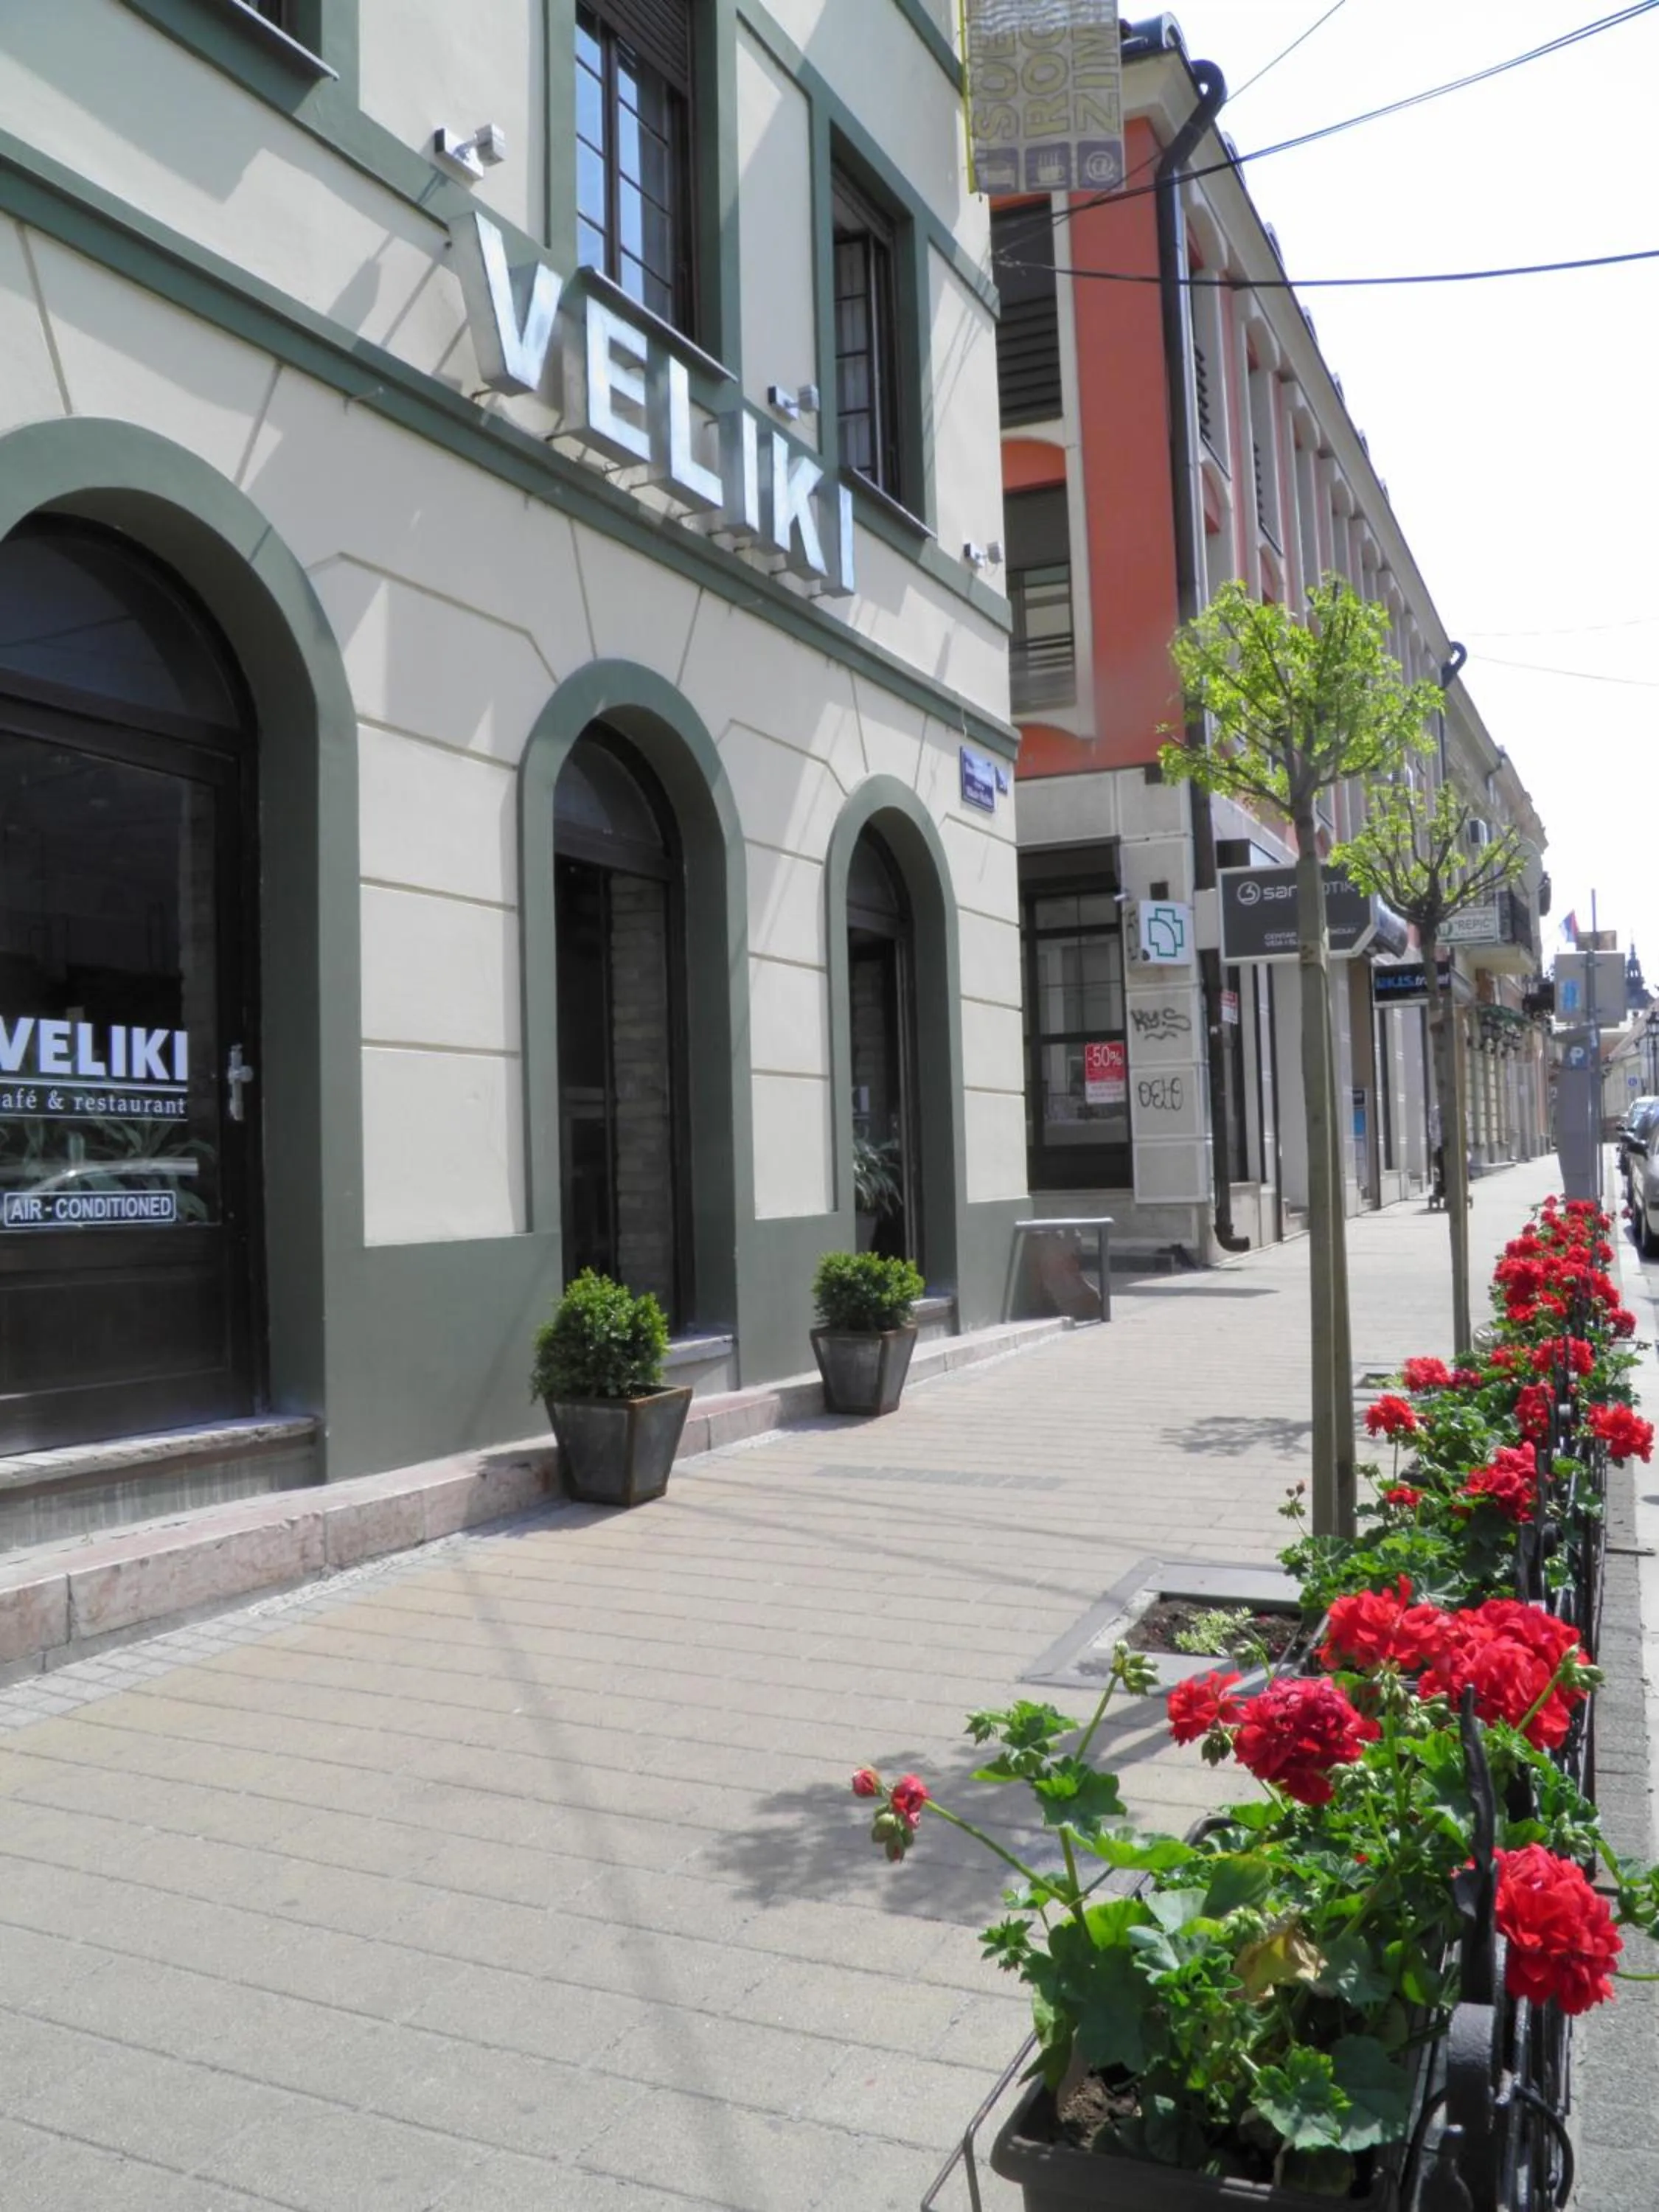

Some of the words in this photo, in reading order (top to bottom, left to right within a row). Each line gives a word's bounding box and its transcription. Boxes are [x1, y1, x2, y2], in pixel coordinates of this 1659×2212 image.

[474, 212, 855, 596] VELIKI
[0, 1015, 189, 1080] VELIKI
[1088, 1044, 1123, 1067] -50%
[1569, 1046, 1585, 1065] P
[0, 1088, 36, 1110] afé
[47, 1091, 64, 1110] &
[74, 1096, 186, 1115] restaurant
